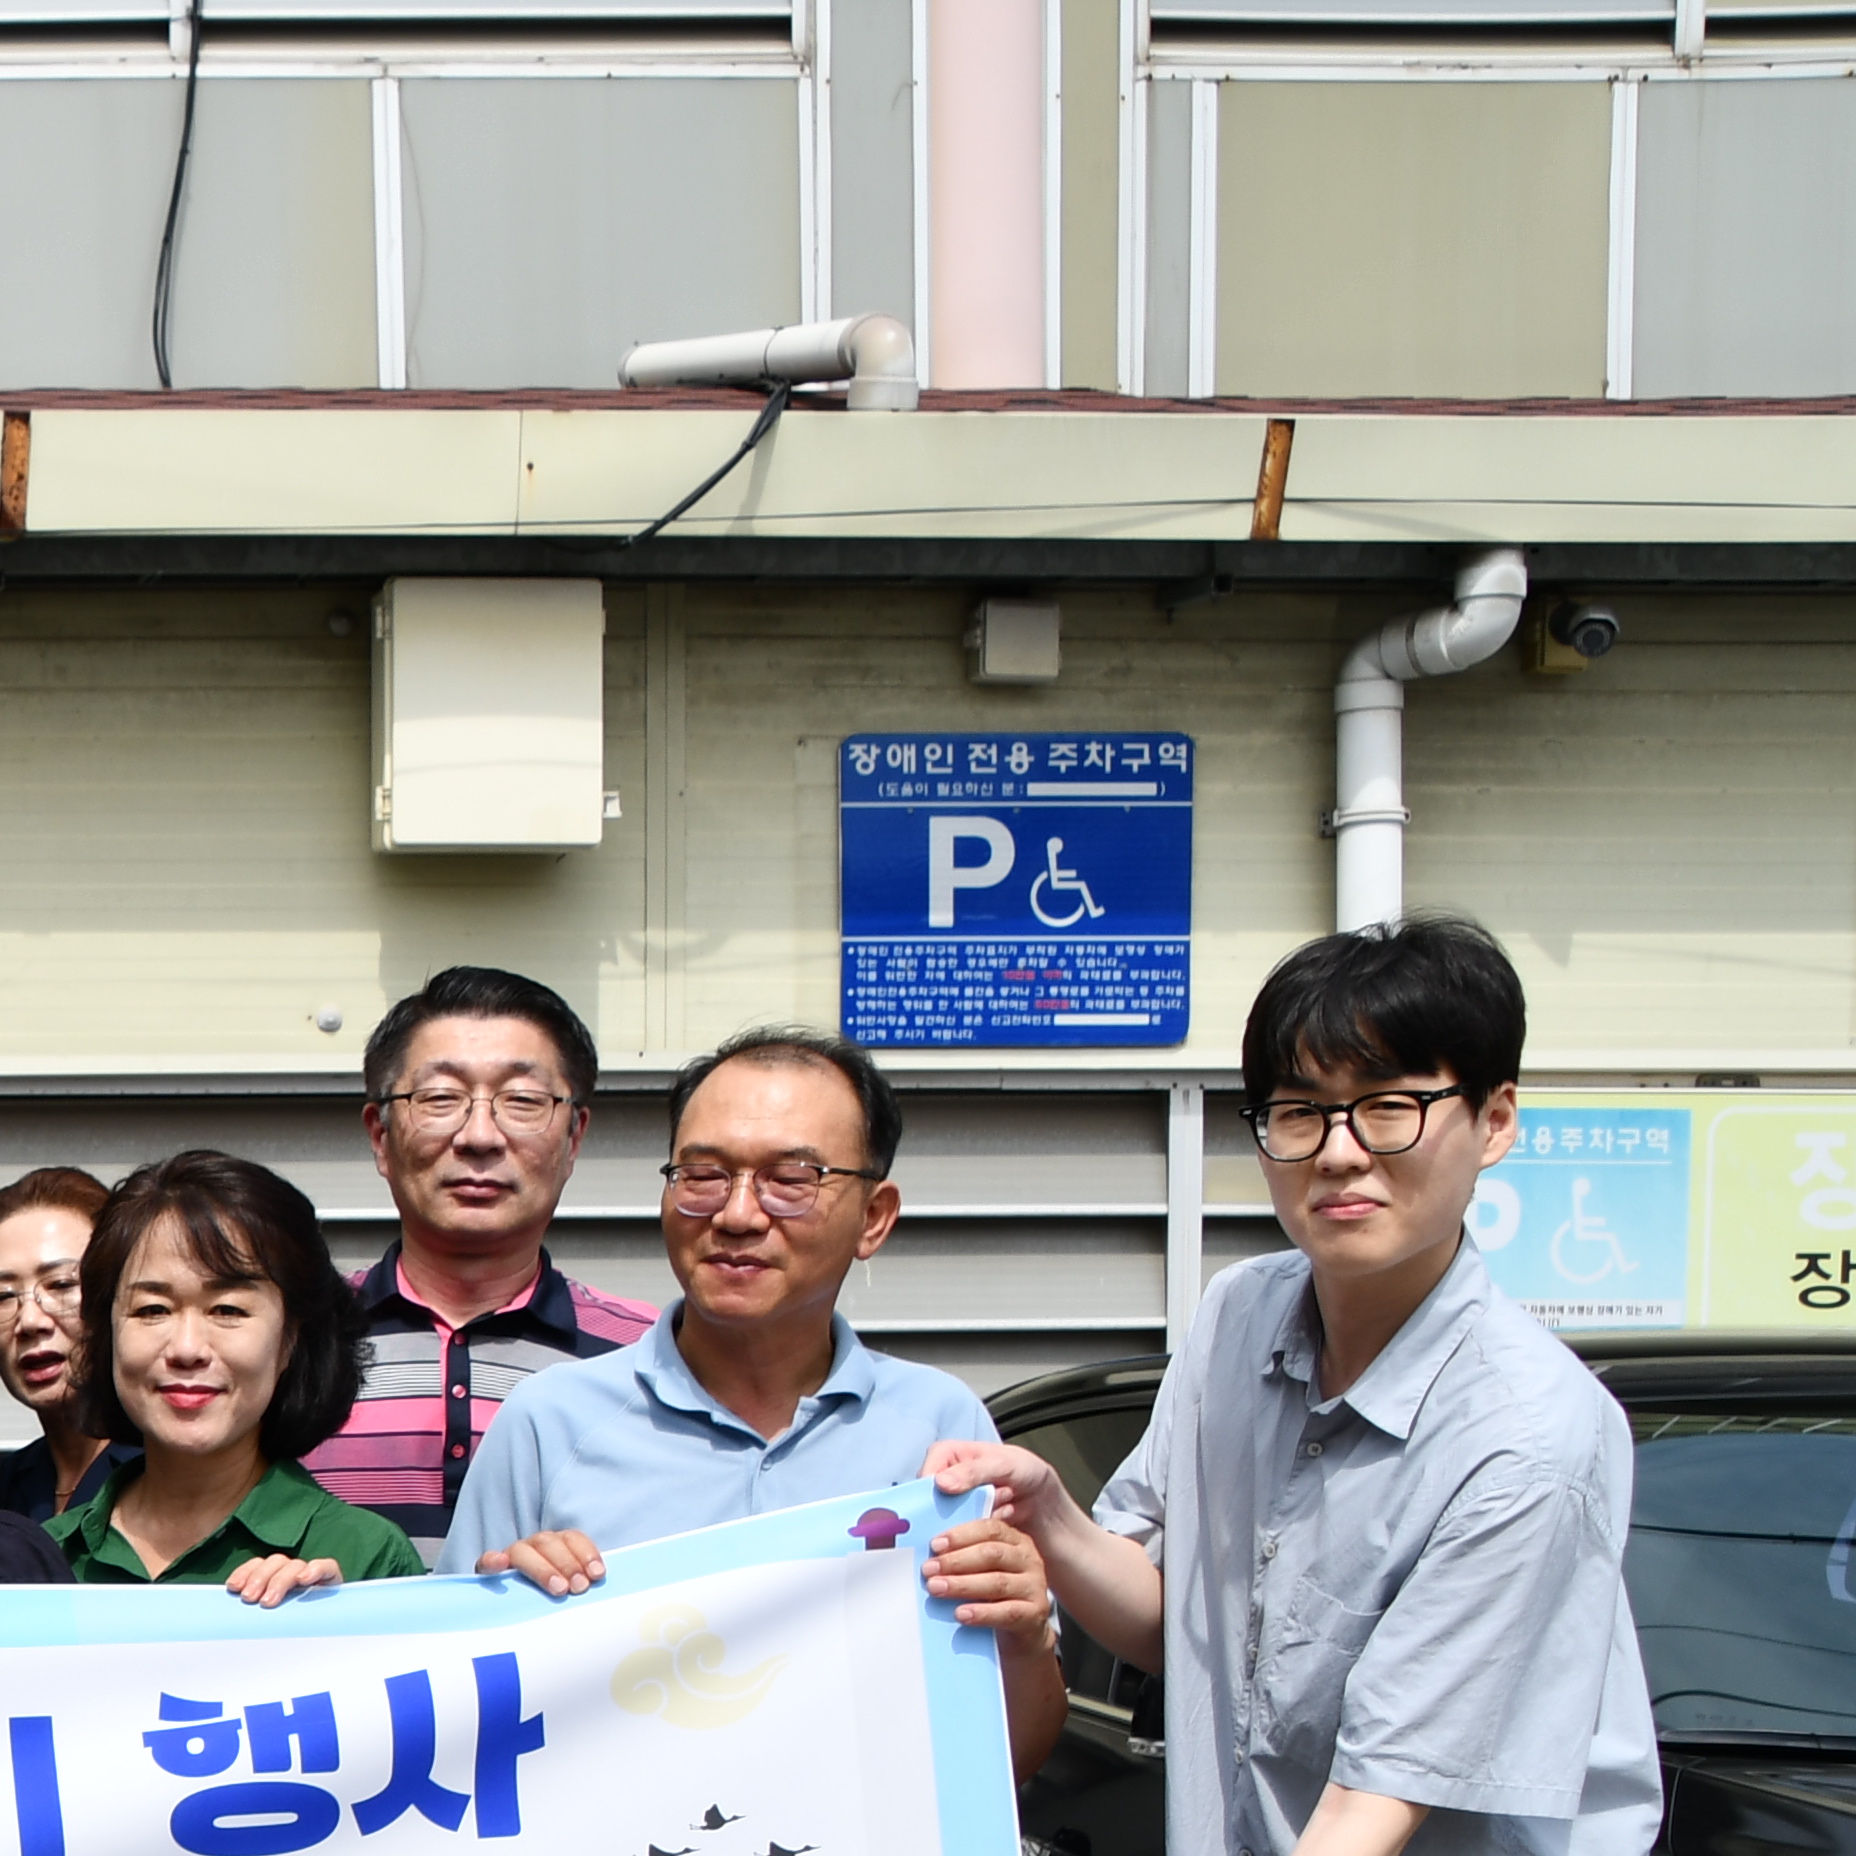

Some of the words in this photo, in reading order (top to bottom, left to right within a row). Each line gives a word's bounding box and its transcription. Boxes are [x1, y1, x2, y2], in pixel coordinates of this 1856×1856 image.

[848, 742, 954, 776] 장애인
[967, 742, 1034, 775] 전용
[1048, 741, 1188, 774] 주차구역
[928, 815, 1016, 929] P
